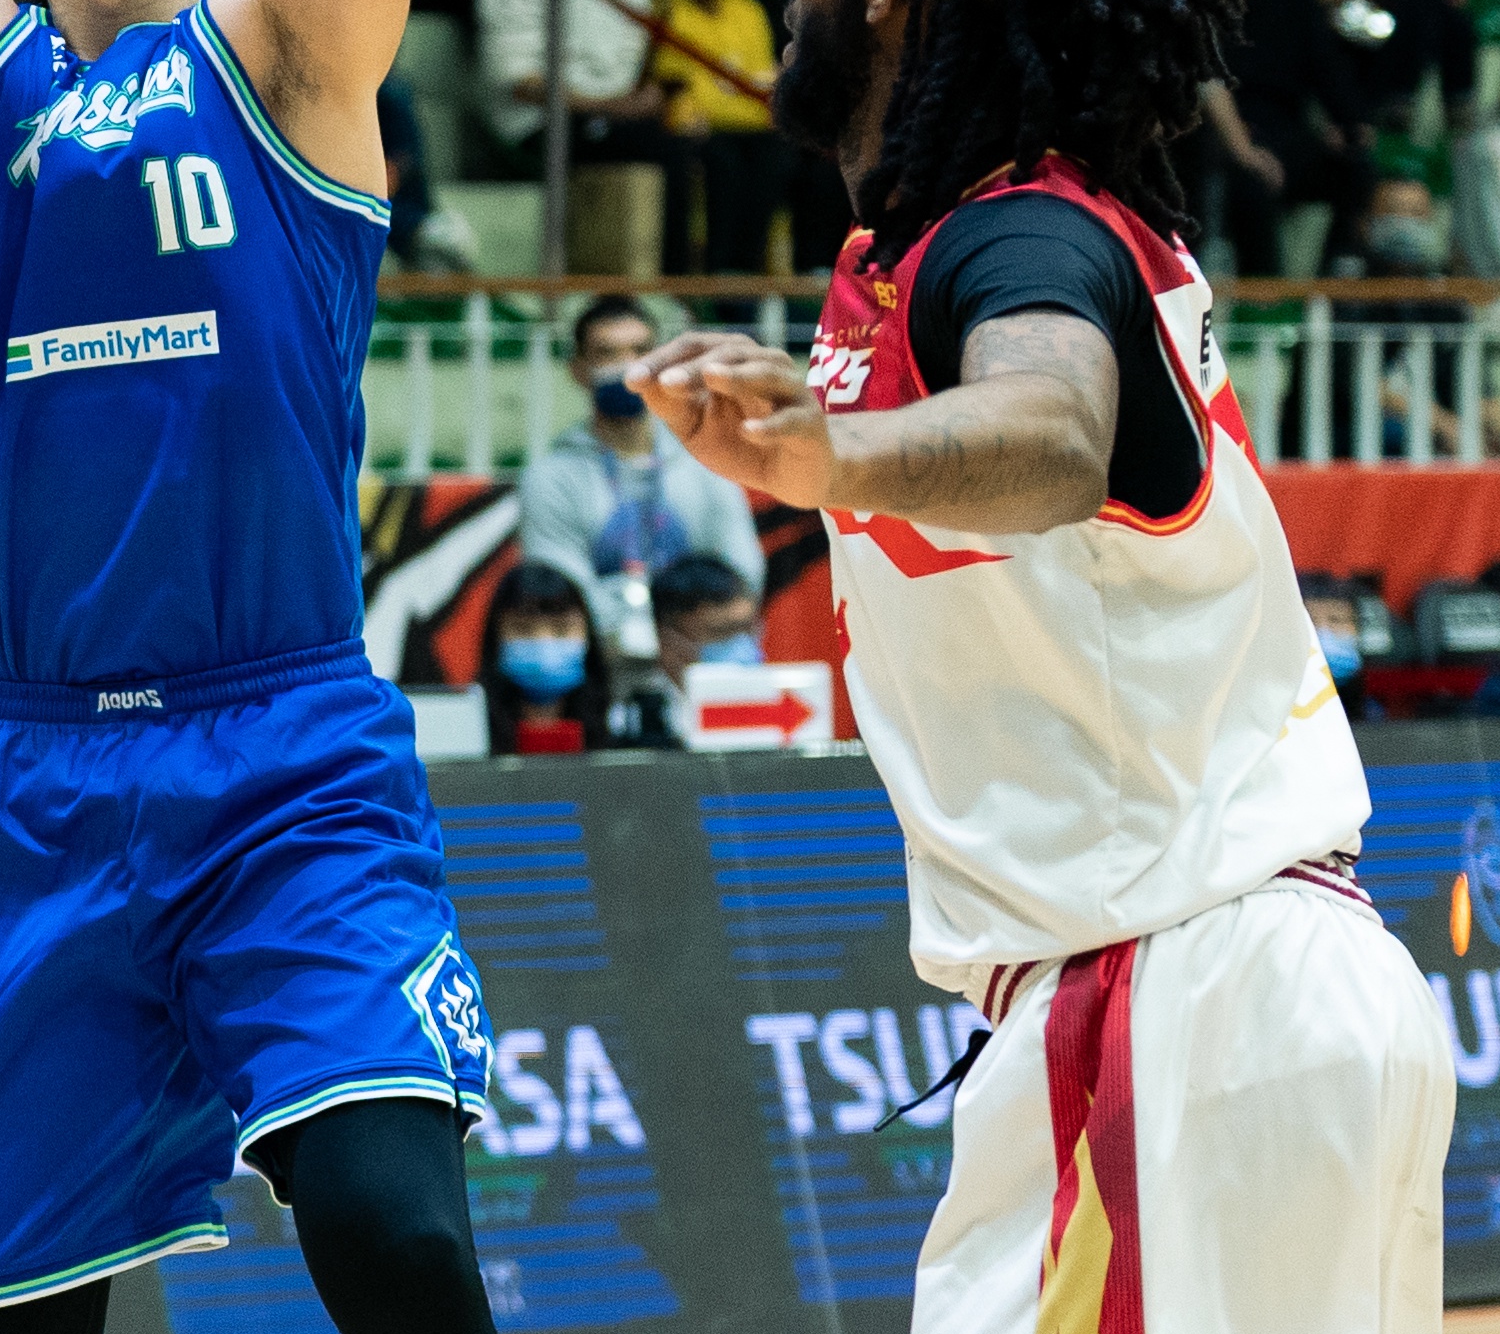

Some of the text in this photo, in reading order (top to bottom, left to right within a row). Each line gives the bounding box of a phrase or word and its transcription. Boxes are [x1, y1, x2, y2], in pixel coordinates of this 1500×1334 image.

[140, 152, 238, 255] 10
[42, 322, 211, 366] FamilyMart
[96, 689, 164, 713] AQUAS
